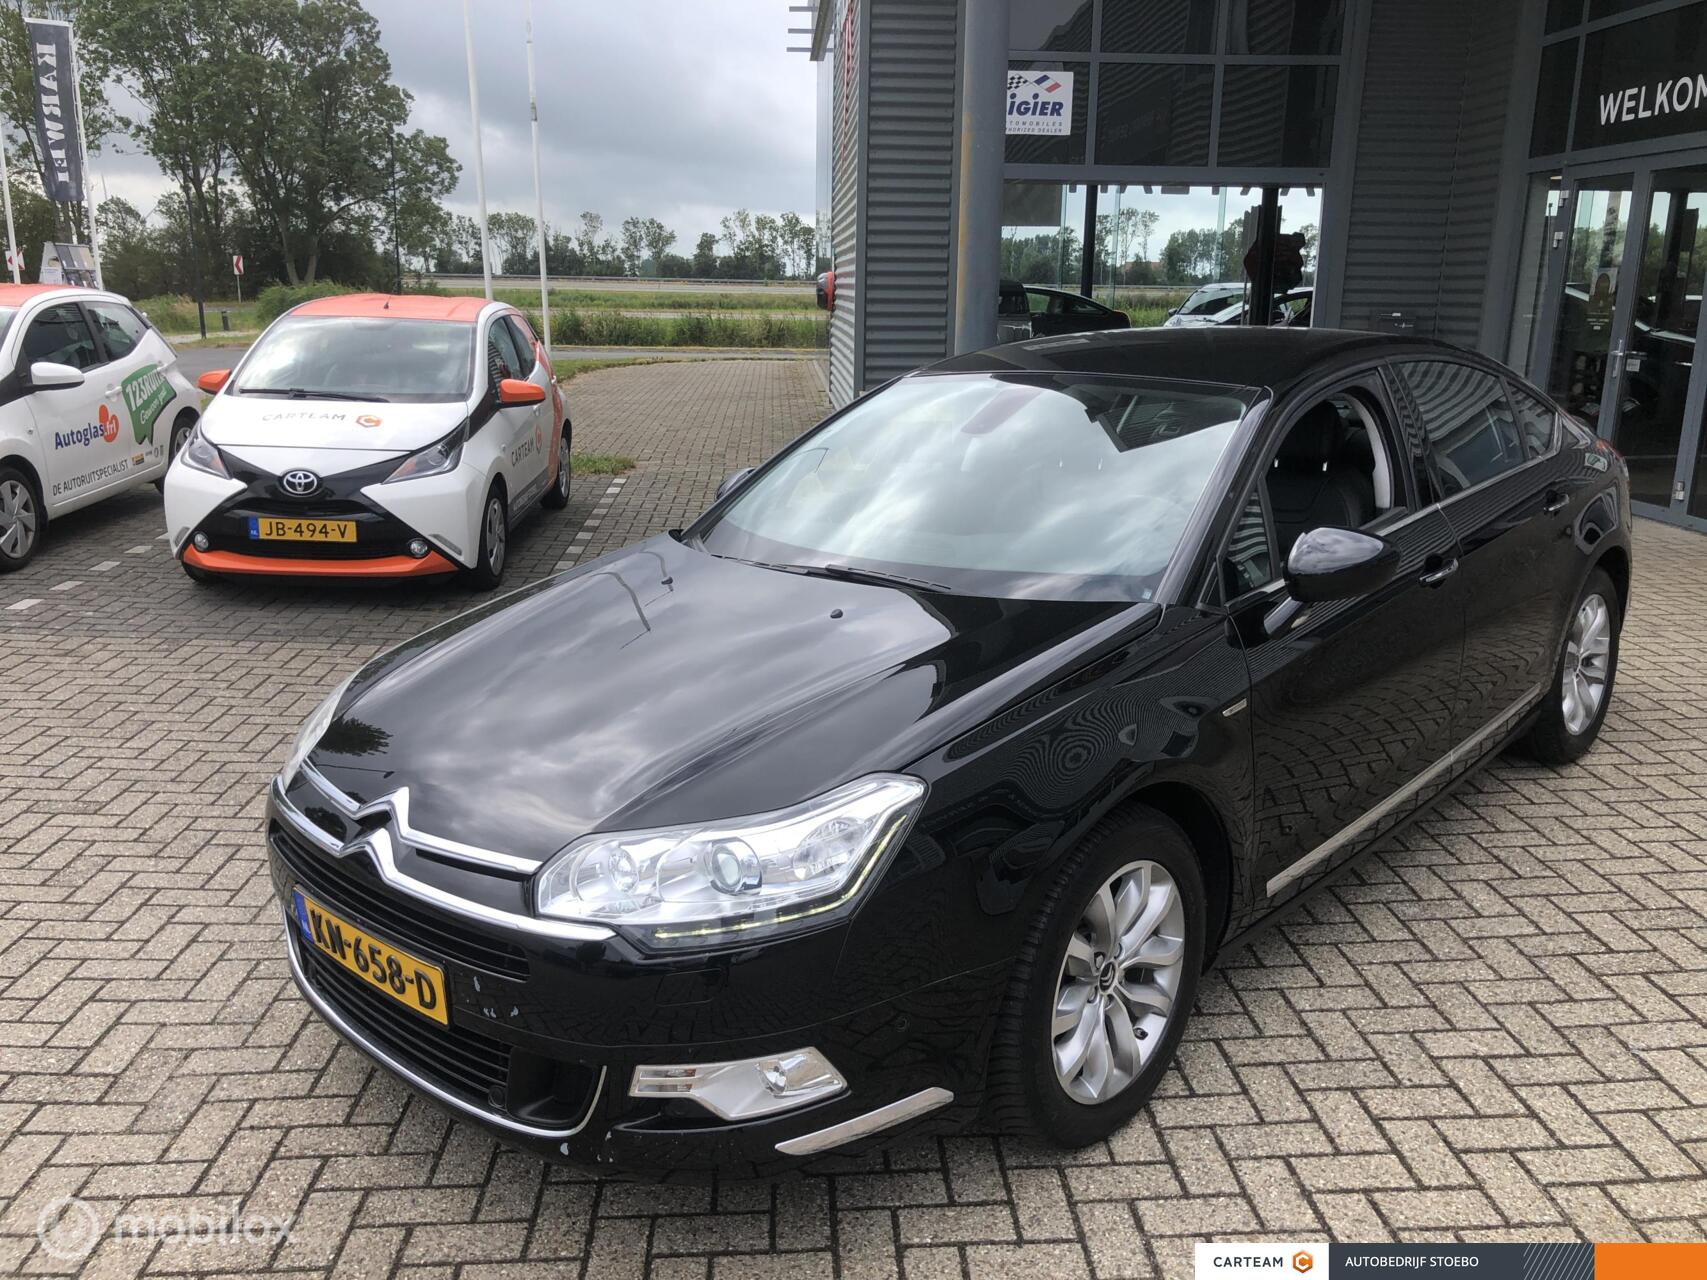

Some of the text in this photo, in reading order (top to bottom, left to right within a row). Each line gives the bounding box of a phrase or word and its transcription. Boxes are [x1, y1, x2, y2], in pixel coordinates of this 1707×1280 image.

[511, 437, 534, 467] CARTEAM
[52, 483, 62, 496] DE
[63, 459, 129, 493] AUTORUITSPECIALIST
[265, 521, 348, 539] JB-494-V
[310, 908, 437, 1010] KN-658-D
